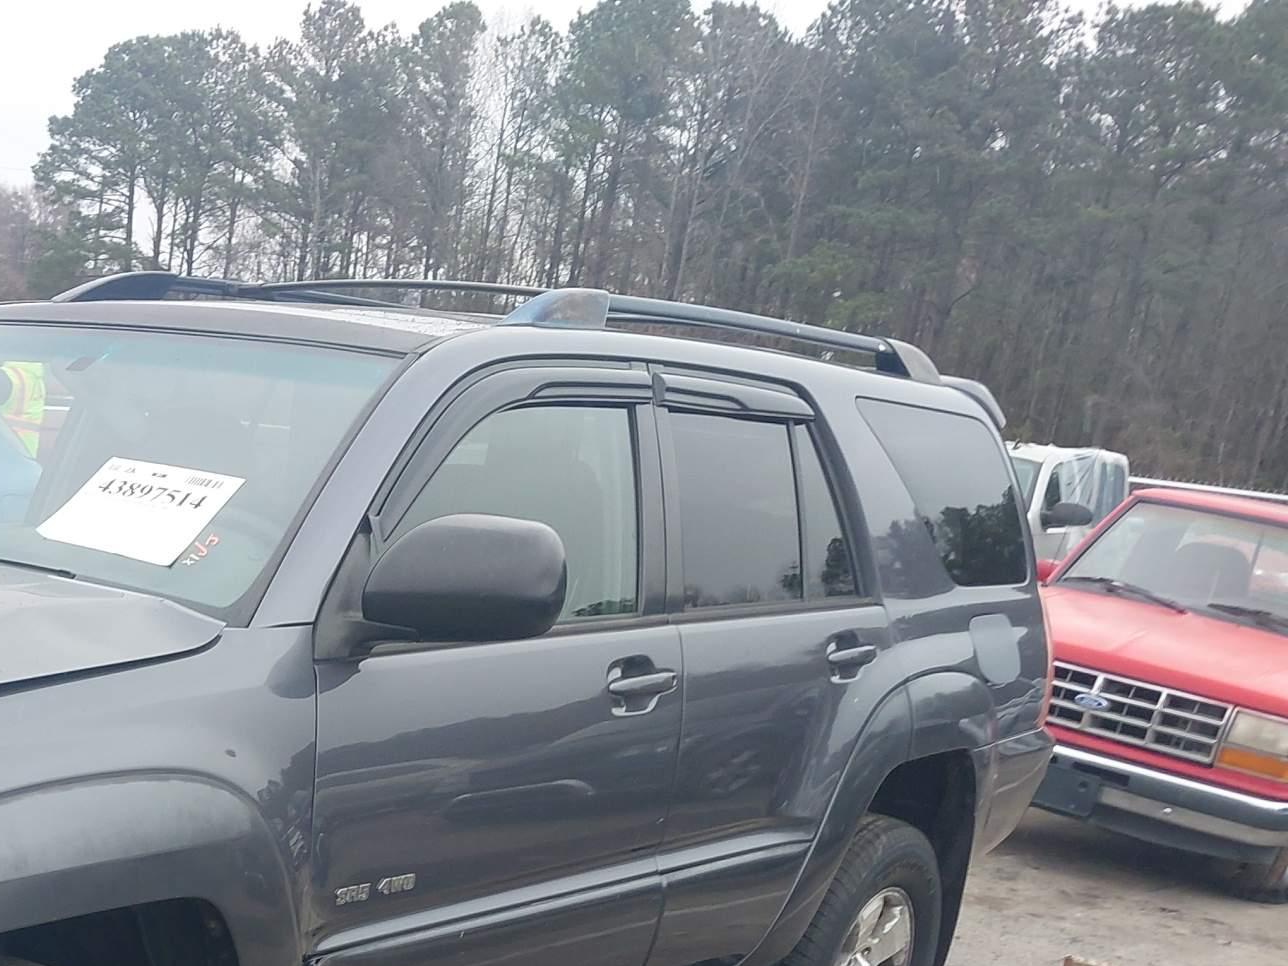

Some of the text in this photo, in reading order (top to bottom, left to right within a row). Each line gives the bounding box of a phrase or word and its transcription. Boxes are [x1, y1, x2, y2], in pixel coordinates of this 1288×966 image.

[98, 478, 208, 509] 43897514
[334, 872, 416, 906] SR5 4WD
